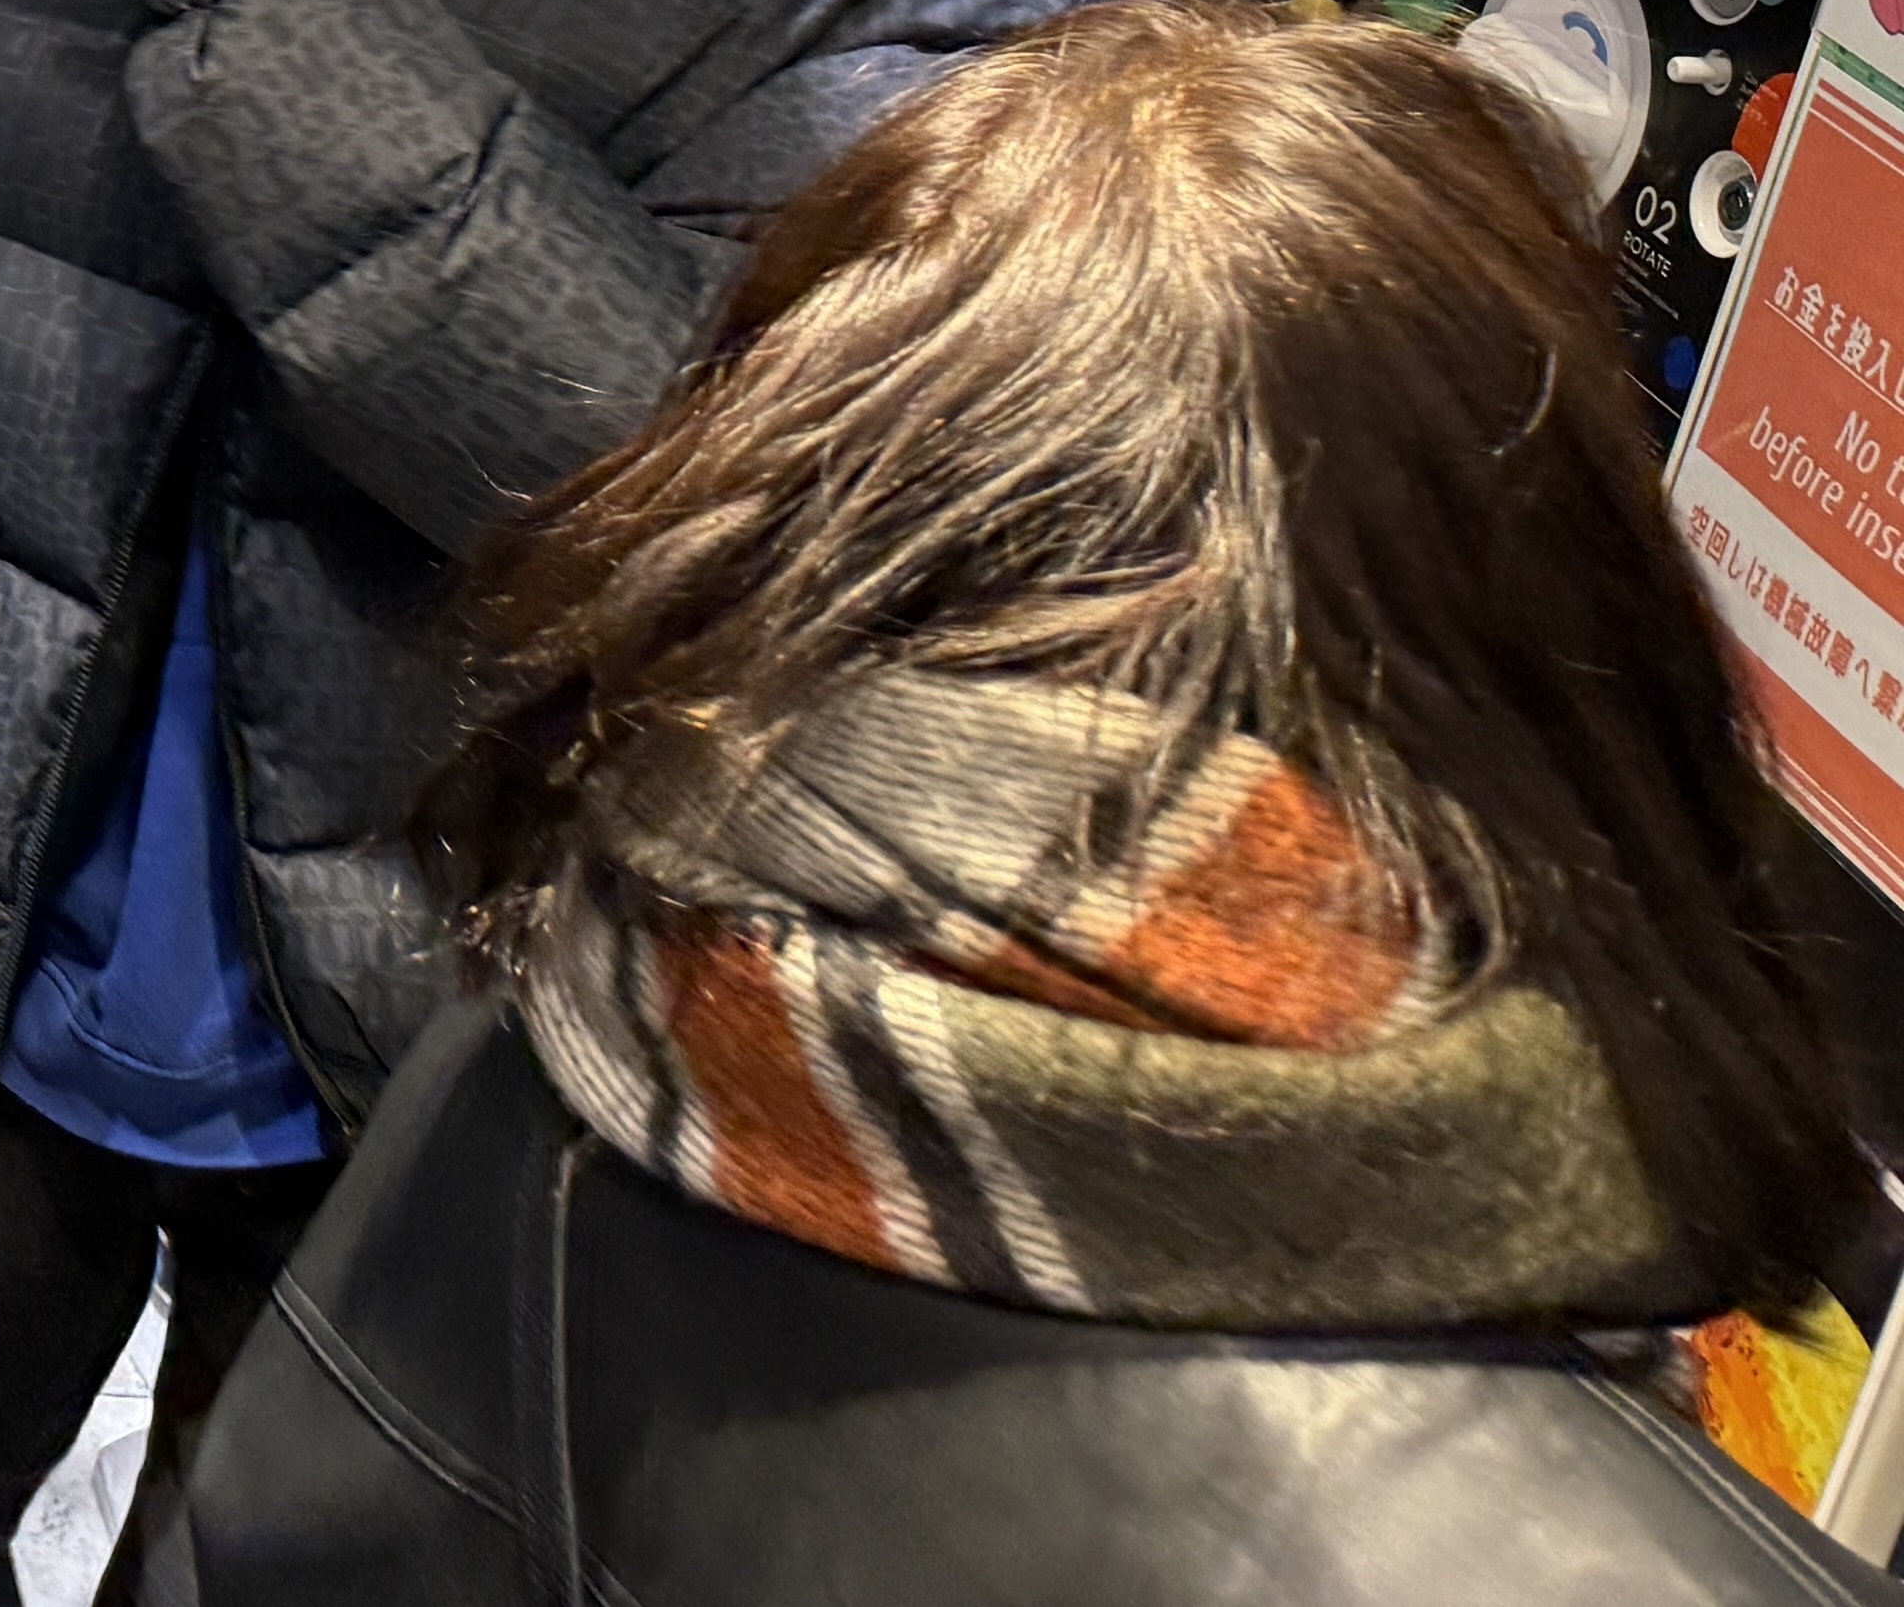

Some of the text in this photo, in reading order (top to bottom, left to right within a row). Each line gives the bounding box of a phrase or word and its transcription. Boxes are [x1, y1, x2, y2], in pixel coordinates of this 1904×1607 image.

[1633, 184, 1678, 246] 02
[1747, 405, 1846, 518] before
[1834, 409, 1882, 476] No
